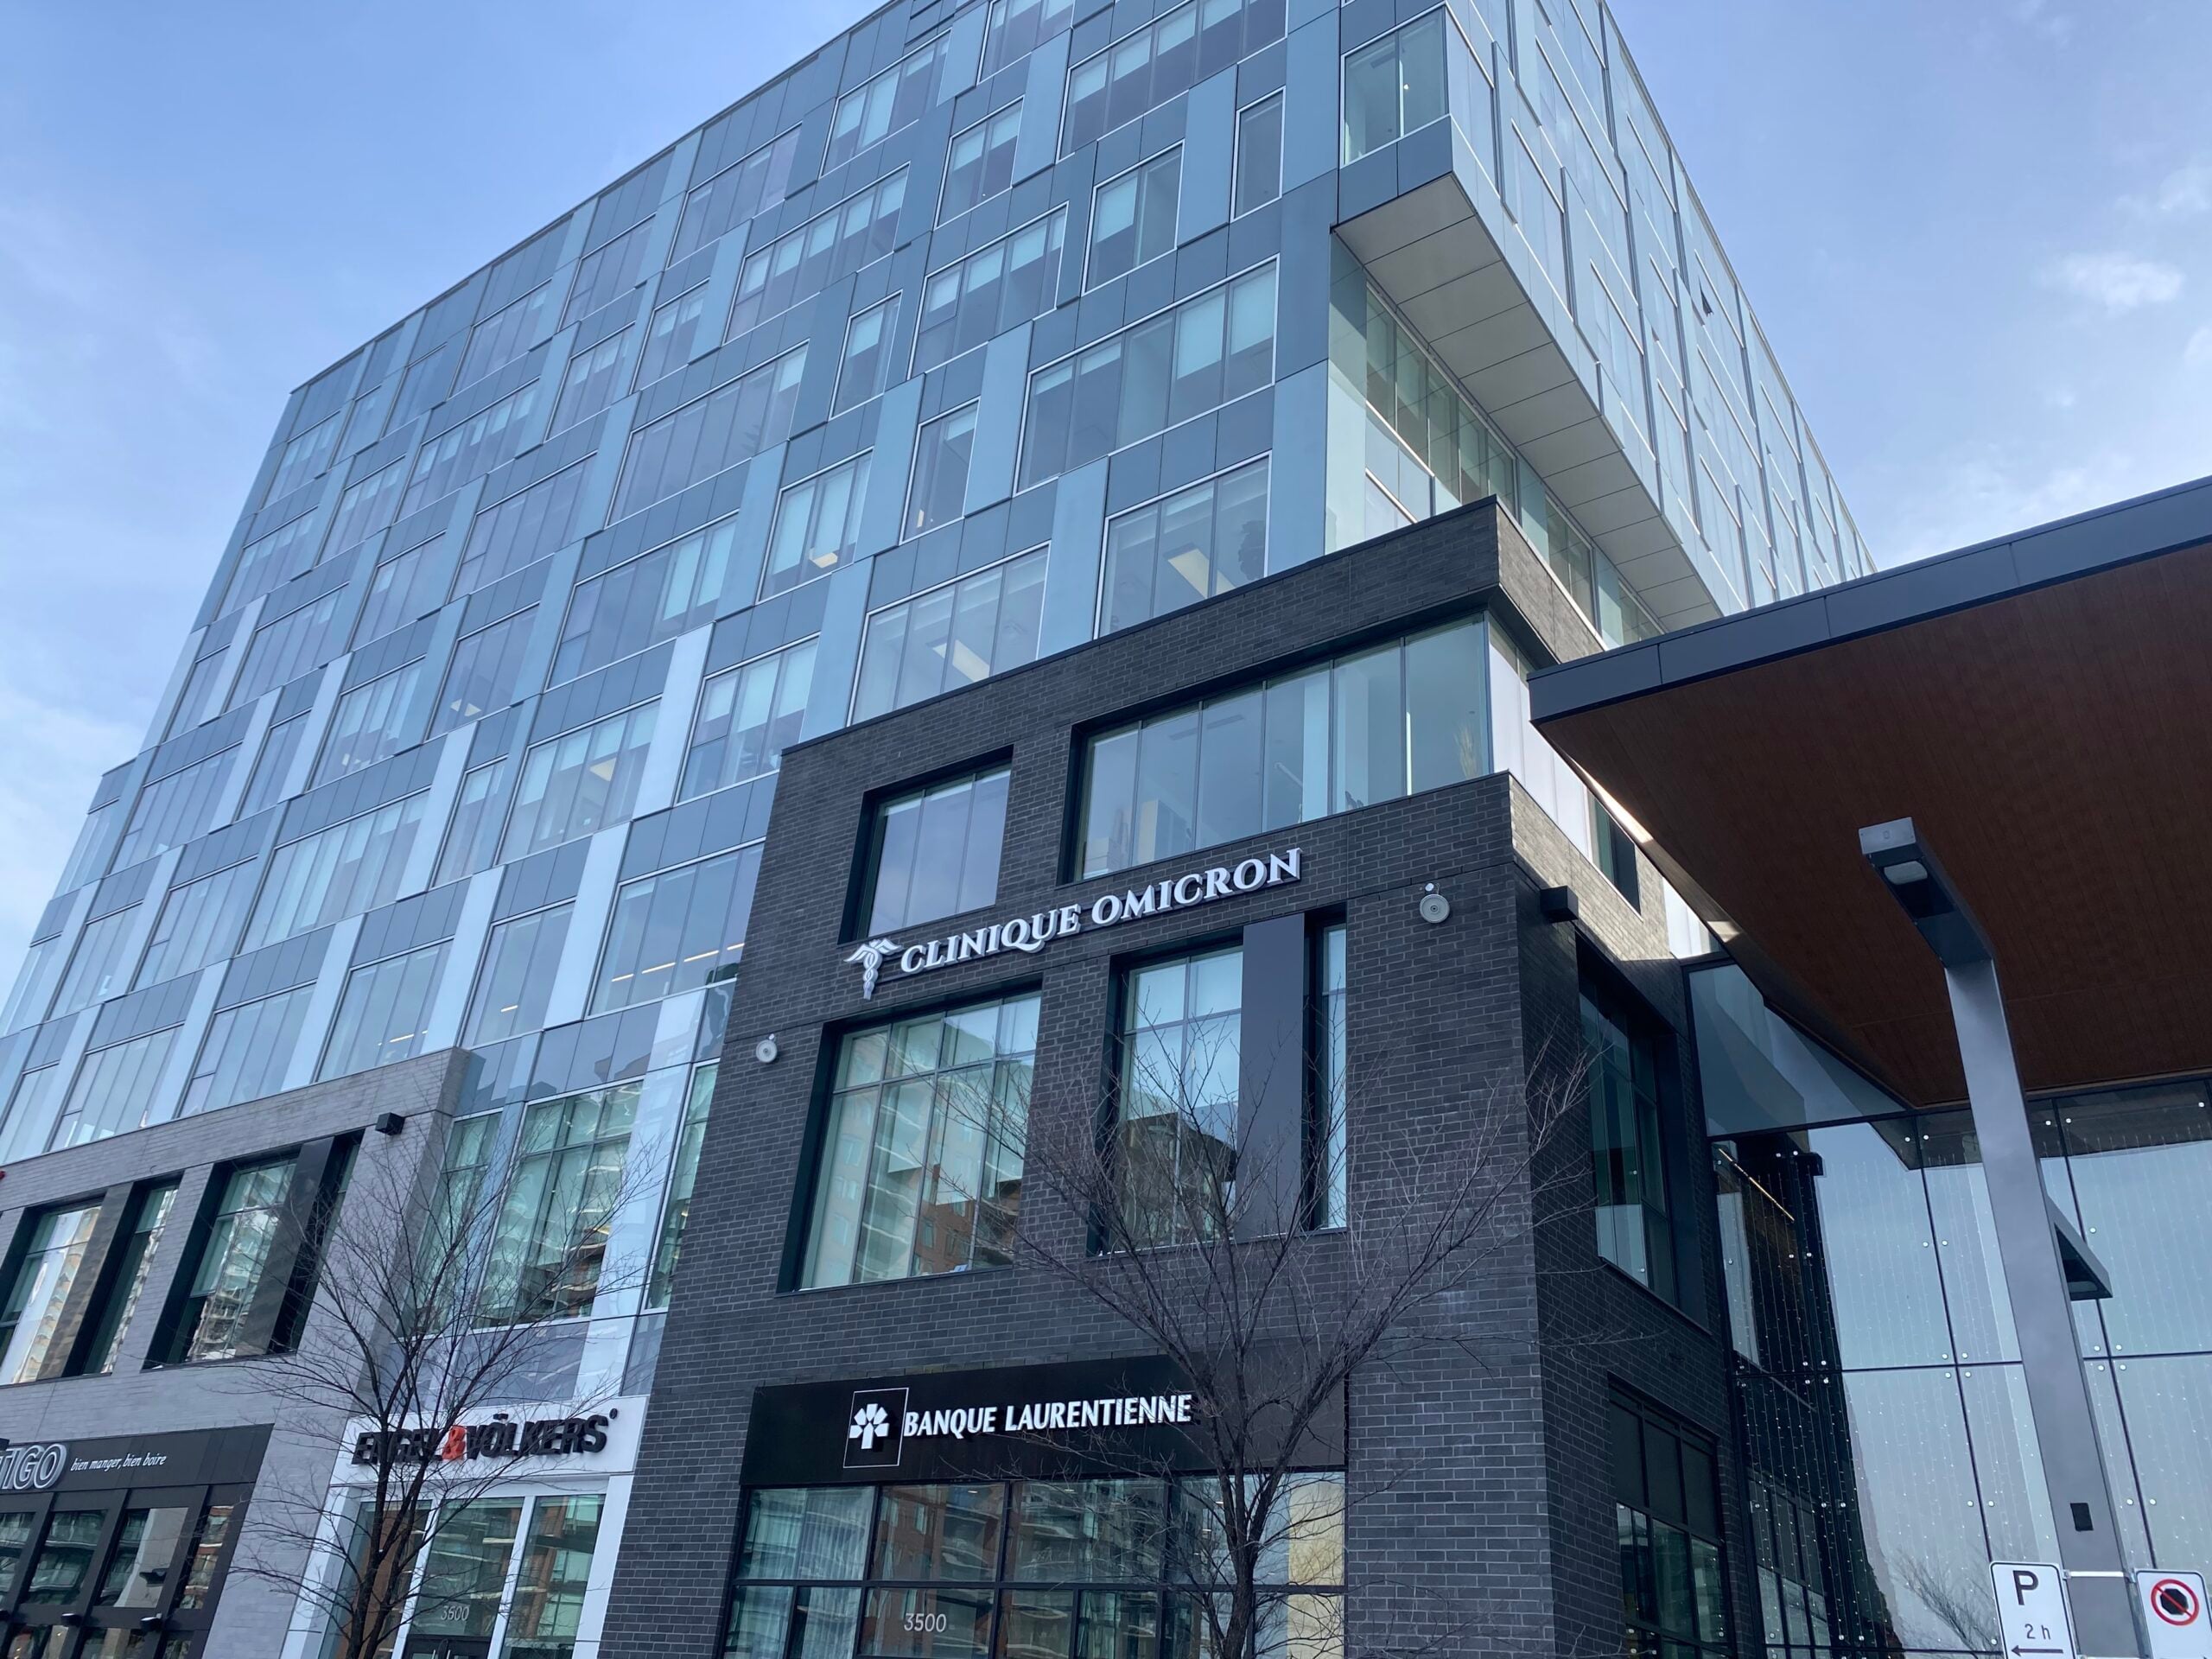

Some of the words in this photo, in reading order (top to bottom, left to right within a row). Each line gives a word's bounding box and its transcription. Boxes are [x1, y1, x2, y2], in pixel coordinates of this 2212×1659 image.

[899, 904, 1082, 975] CLINIQUE
[1091, 848, 1303, 927] OMICRON
[903, 1406, 997, 1440] BANQUE
[1005, 1394, 1192, 1432] LAURENTIENNE
[70, 1458, 88, 1471] bien
[89, 1458, 122, 1472] manger,
[123, 1453, 143, 1467] bien
[143, 1452, 167, 1466] boire
[2012, 1569, 2039, 1606] P
[903, 1612, 947, 1633] 3500
[2024, 1623, 2036, 1640] 2
[2041, 1624, 2051, 1640] h
